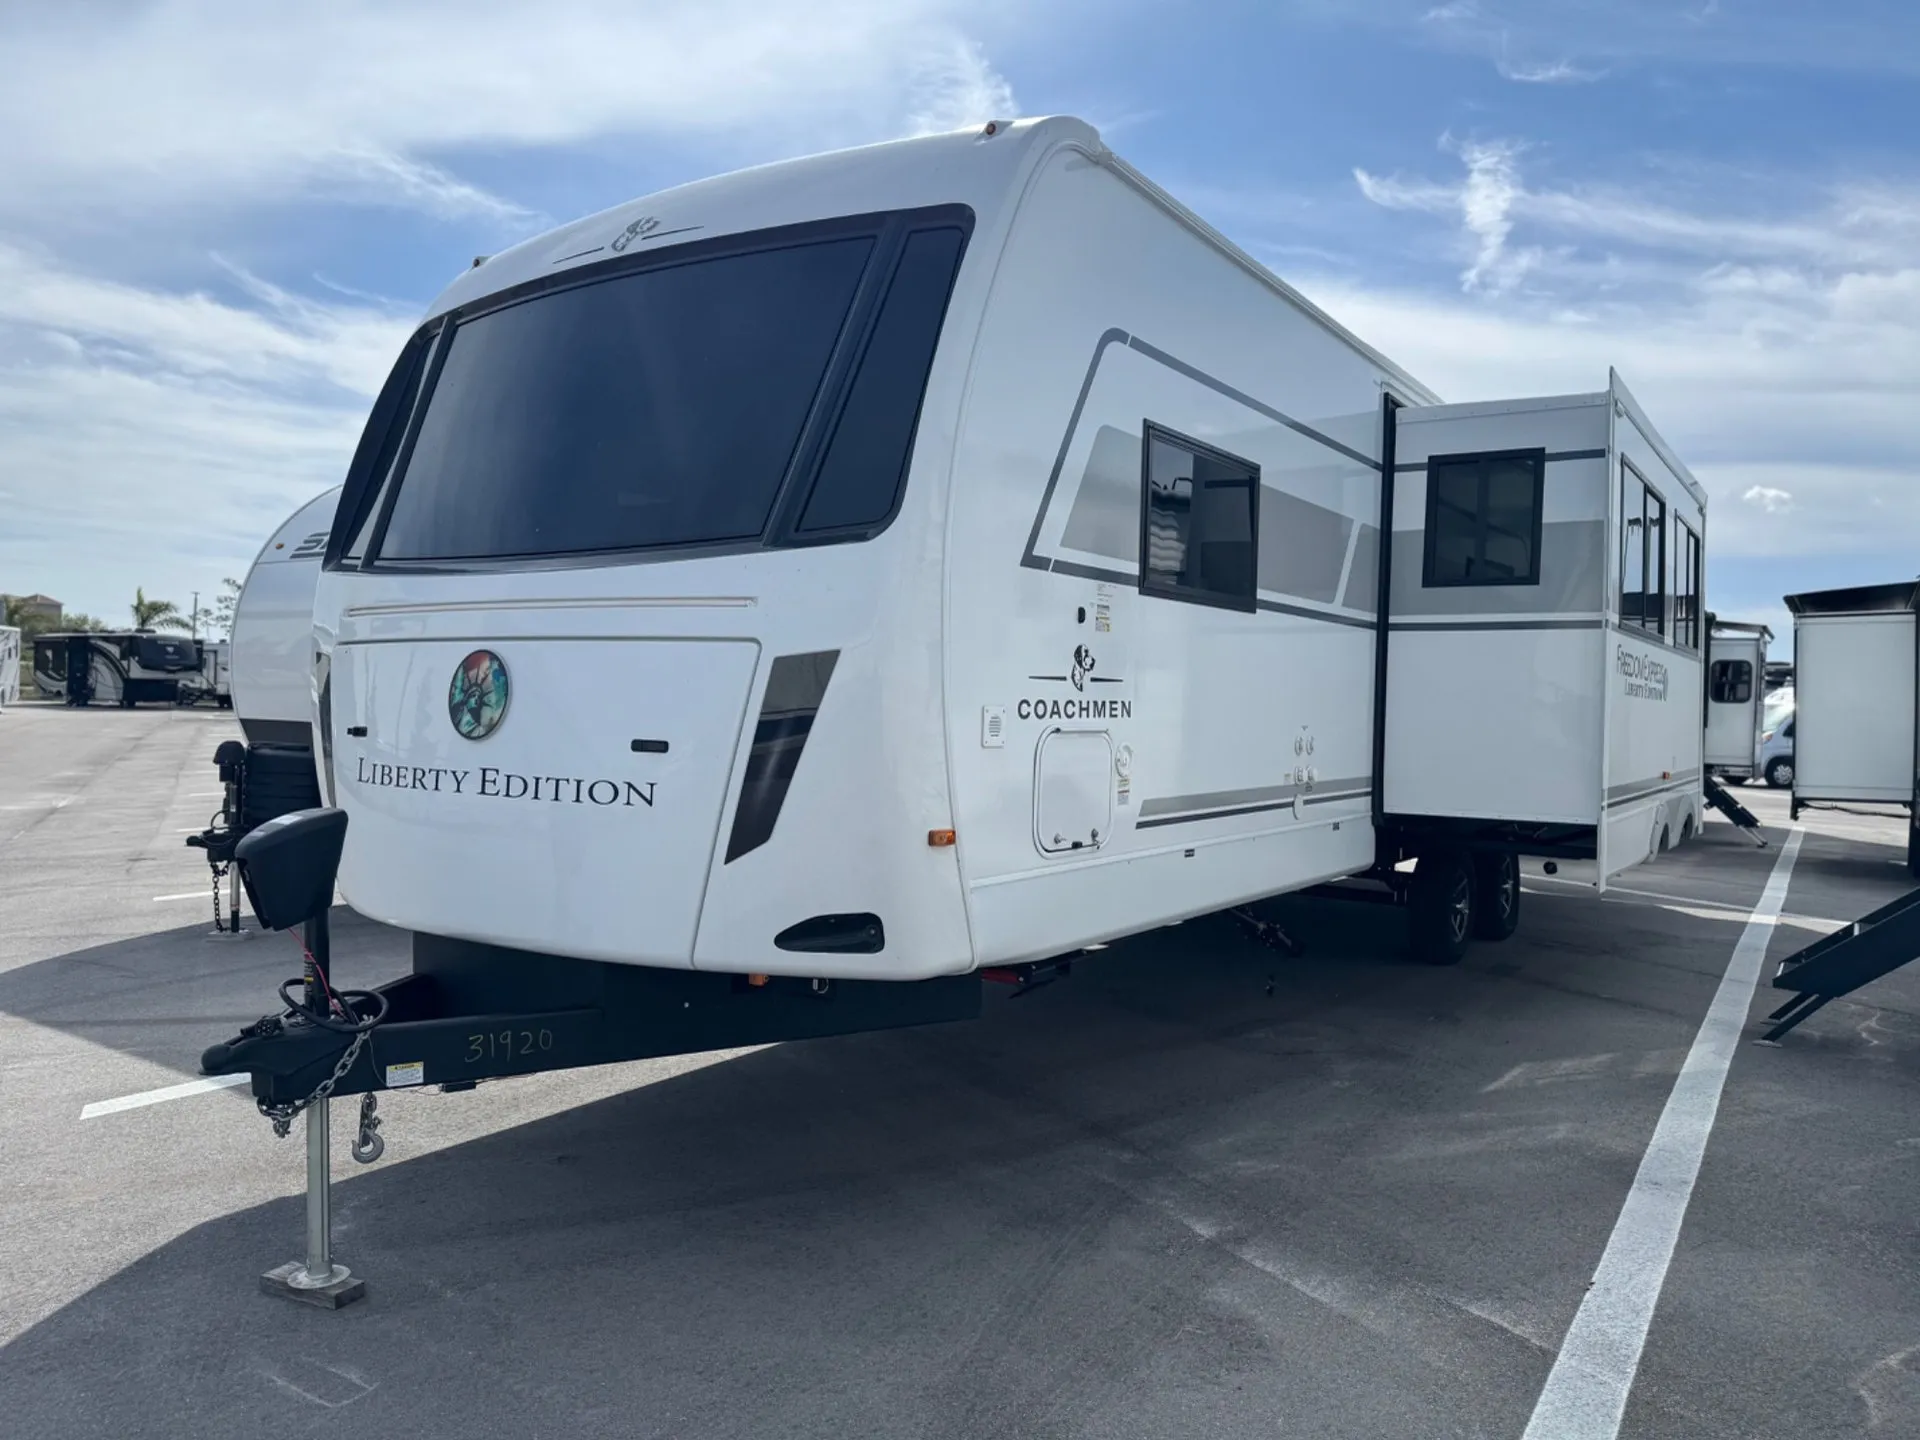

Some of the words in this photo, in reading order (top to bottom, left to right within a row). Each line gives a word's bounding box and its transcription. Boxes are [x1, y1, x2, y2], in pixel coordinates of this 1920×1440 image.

[1017, 698, 1132, 720] COACHMEN
[356, 757, 469, 794] LIBERTY
[476, 767, 658, 807] EDITION
[464, 1028, 553, 1063] 31920
